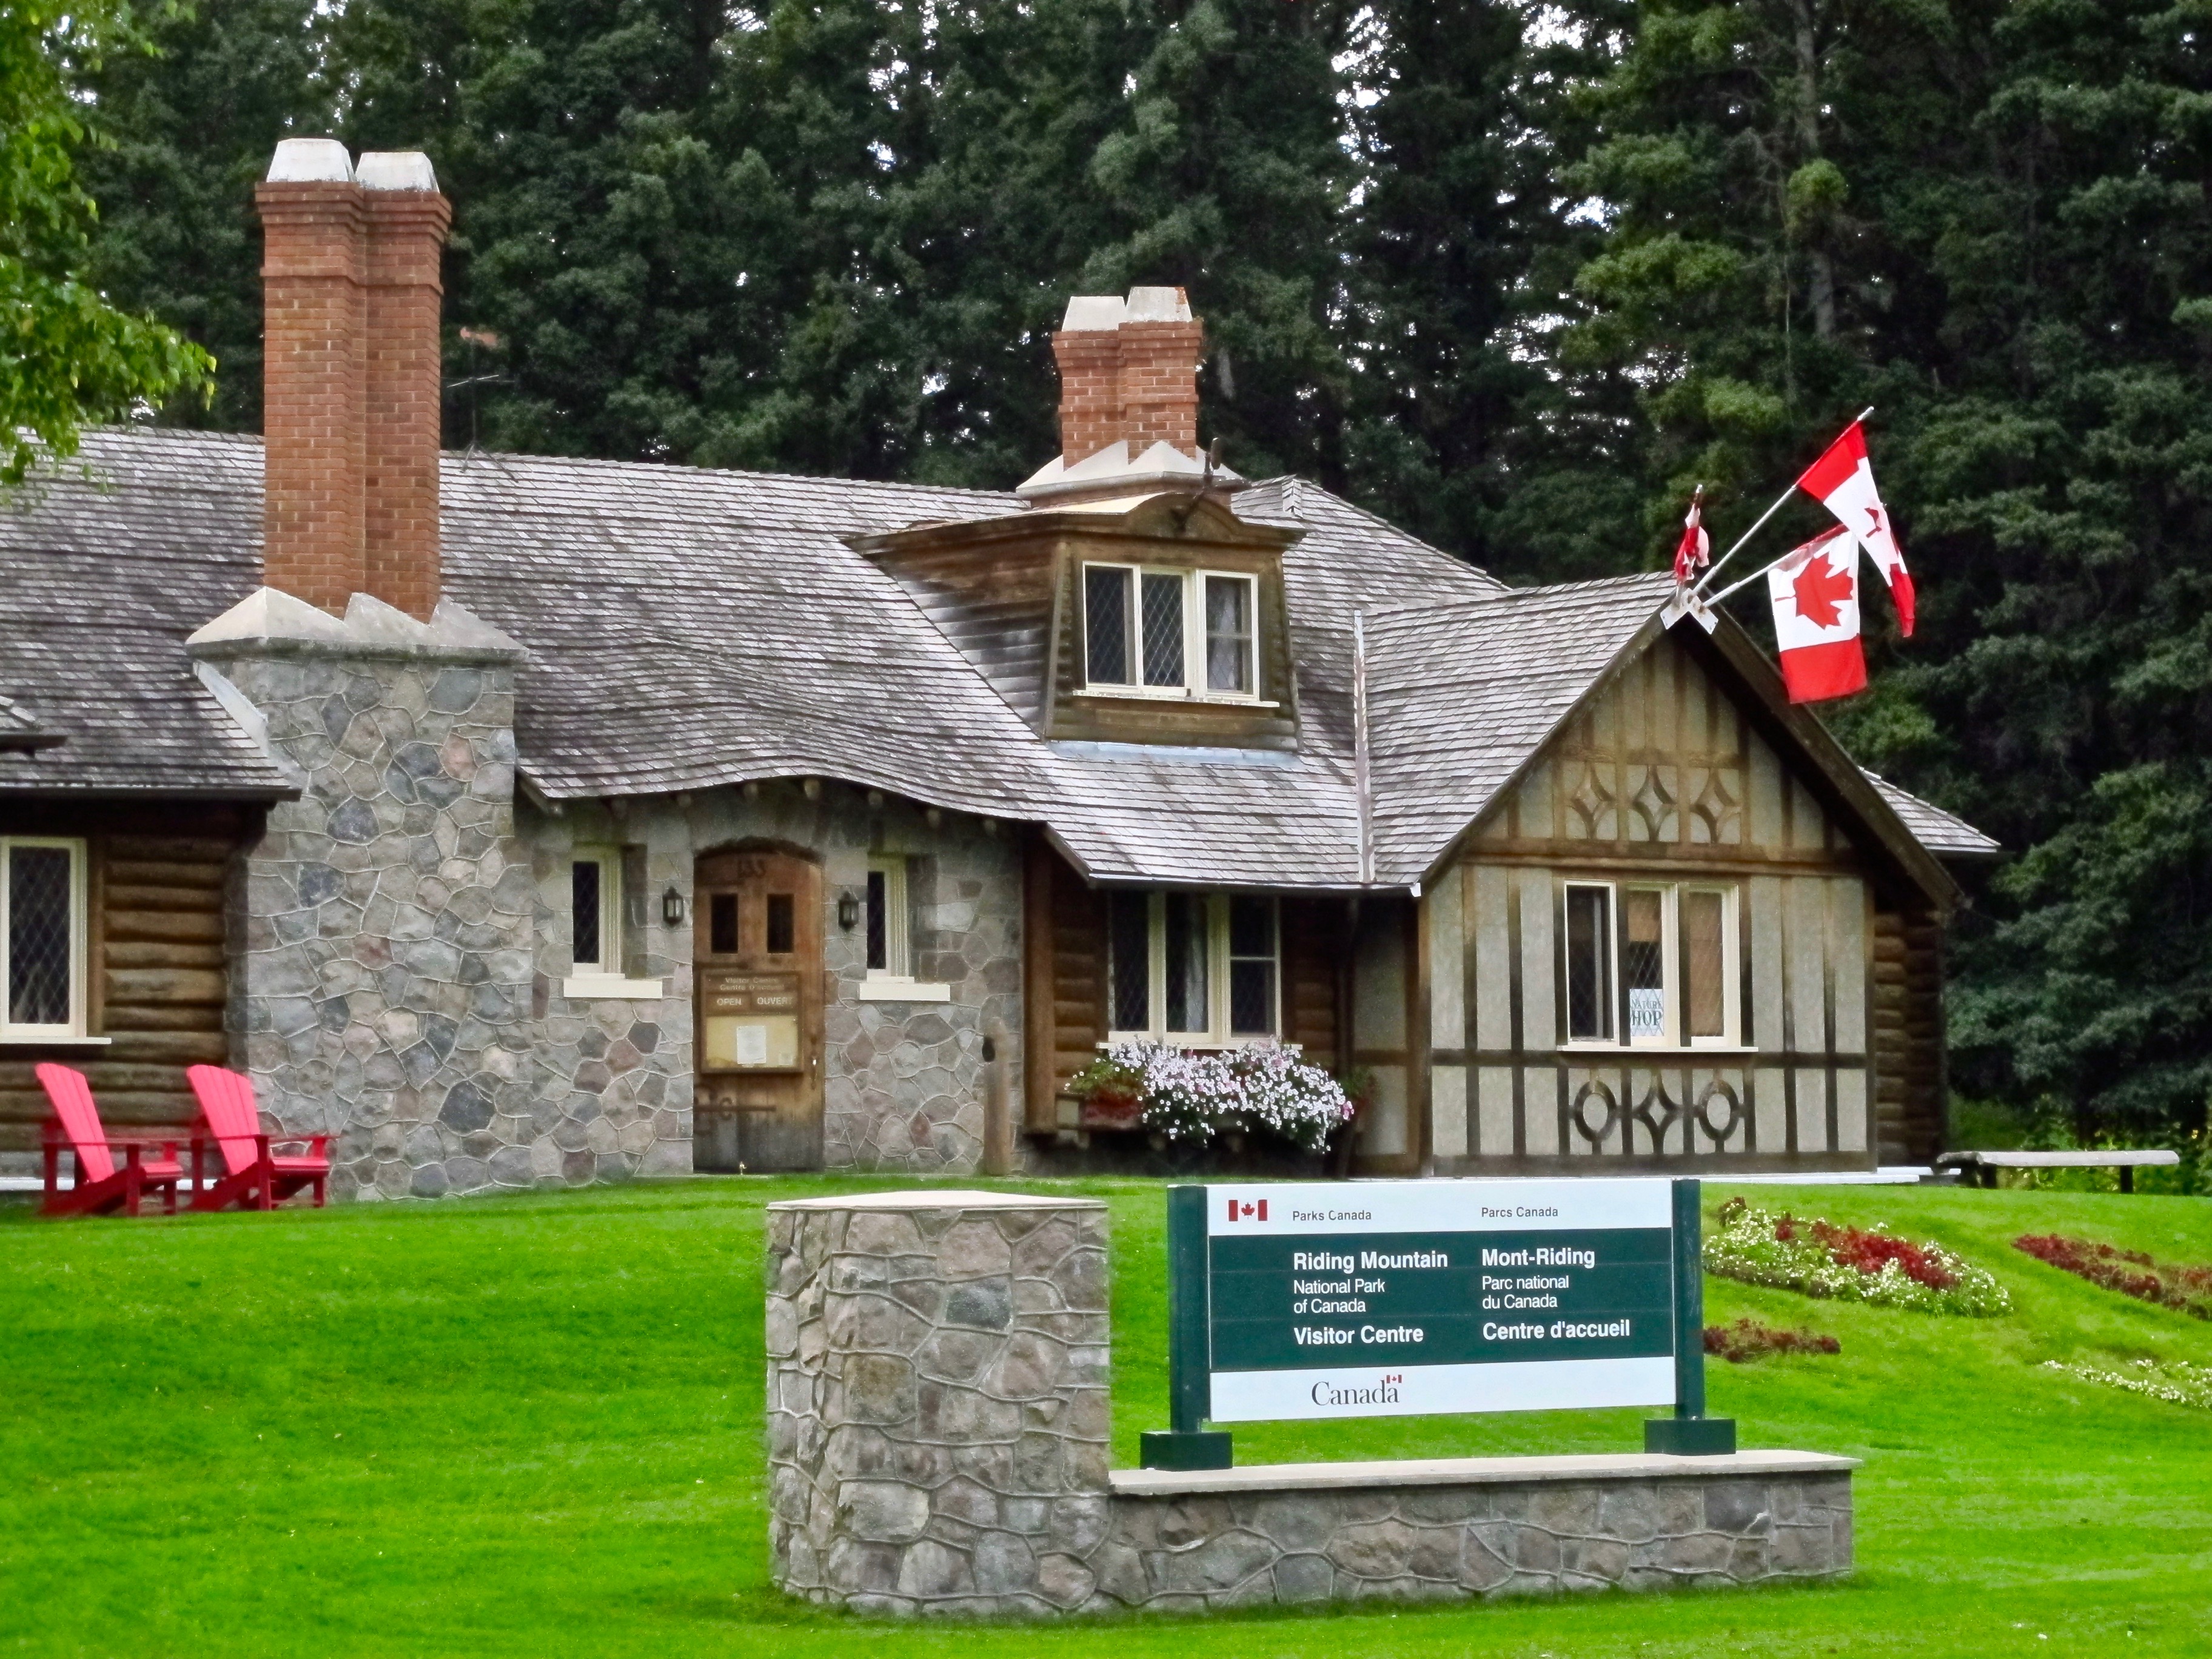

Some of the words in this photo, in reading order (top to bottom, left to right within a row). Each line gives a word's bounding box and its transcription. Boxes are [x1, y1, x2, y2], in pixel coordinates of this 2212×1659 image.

[1293, 1210, 1325, 1221] Parks
[1328, 1210, 1372, 1221] Canada
[1481, 1207, 1512, 1218] Parcs
[1516, 1207, 1558, 1218] Canada
[1293, 1252, 1355, 1274] Riding
[1361, 1250, 1448, 1269] Mountain
[1482, 1247, 1595, 1269] Mont-Riding
[1293, 1279, 1350, 1295] National
[1355, 1278, 1386, 1293] Park
[1482, 1275, 1513, 1290] Parc
[1517, 1275, 1569, 1289] national
[1293, 1298, 1308, 1314] of
[1310, 1298, 1366, 1313] Canada
[1482, 1295, 1500, 1309] du
[1504, 1293, 1558, 1309] Canada
[1293, 1326, 1355, 1345] Visitor
[1360, 1325, 1424, 1344] Centre
[1483, 1322, 1545, 1341] Centre
[1550, 1319, 1630, 1338] d'accueil
[1312, 1379, 1400, 1406] Canada
